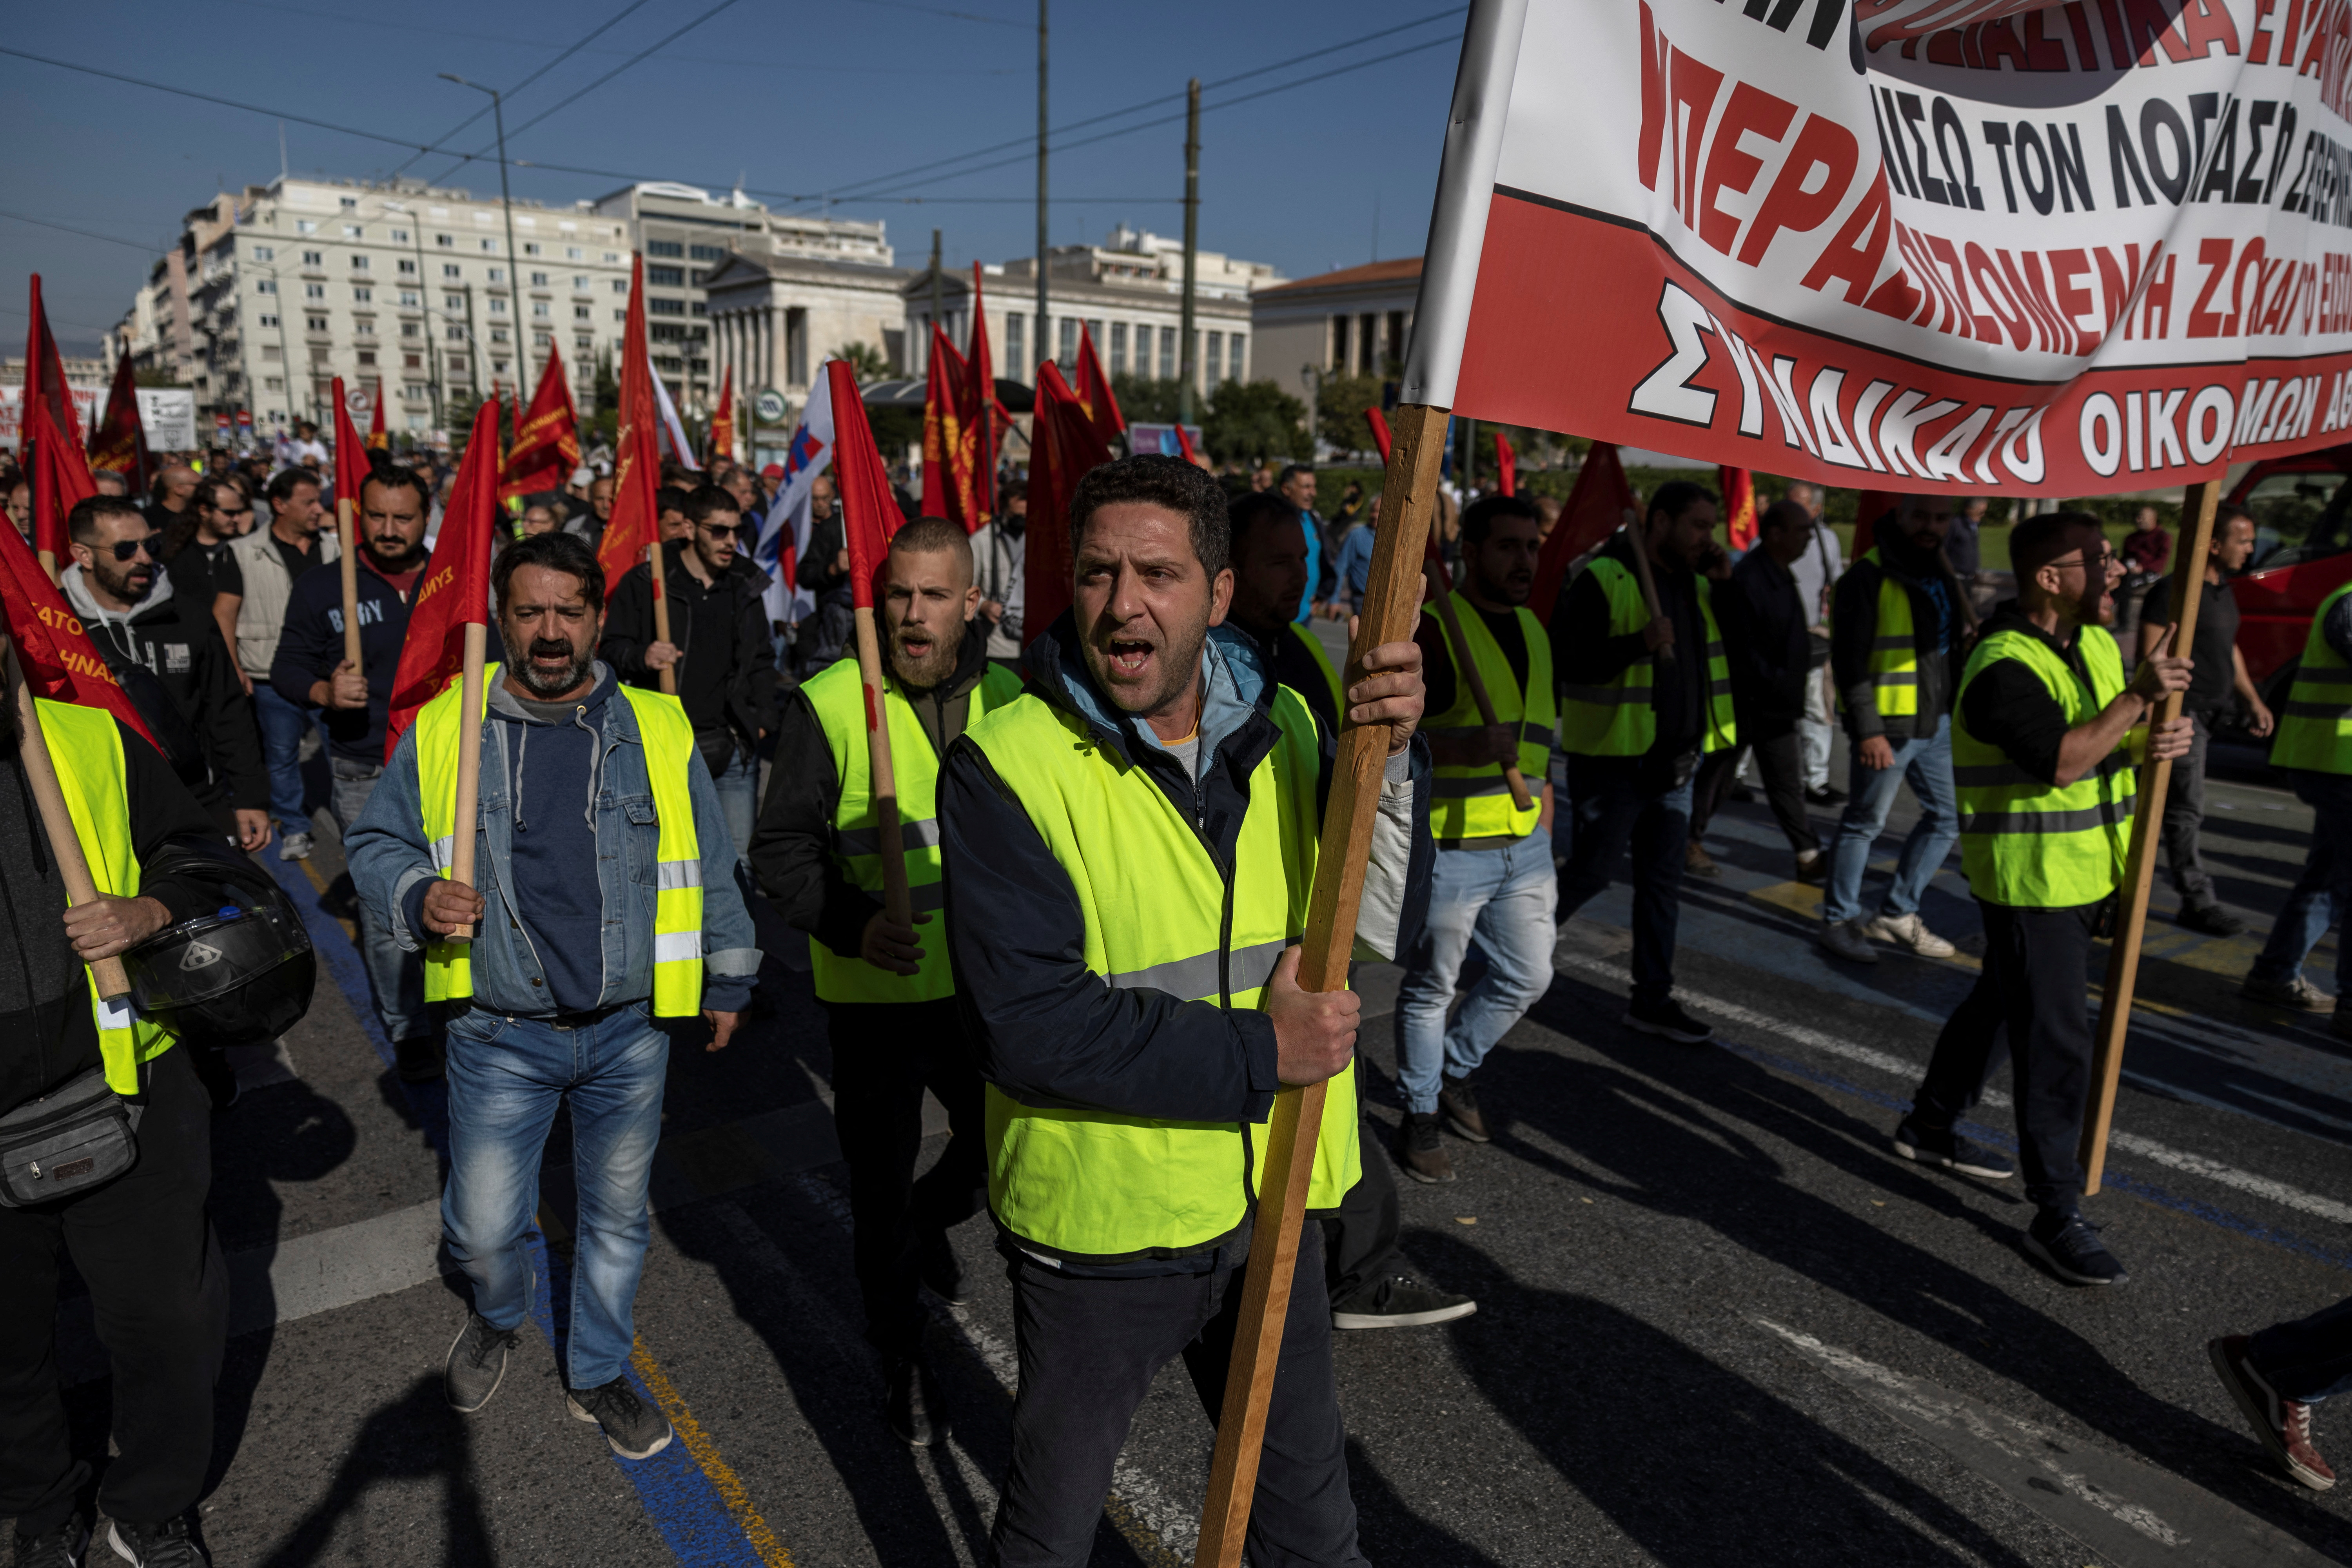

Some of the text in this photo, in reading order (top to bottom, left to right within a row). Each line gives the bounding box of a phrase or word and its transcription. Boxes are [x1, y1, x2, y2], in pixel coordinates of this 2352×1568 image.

[1982, 120, 2096, 216] ΤΟΝ
[1626, 277, 2047, 485] ΣΥΝΔΙΚΑΤΟ
[31, 602, 83, 635] ΑΤΟ
